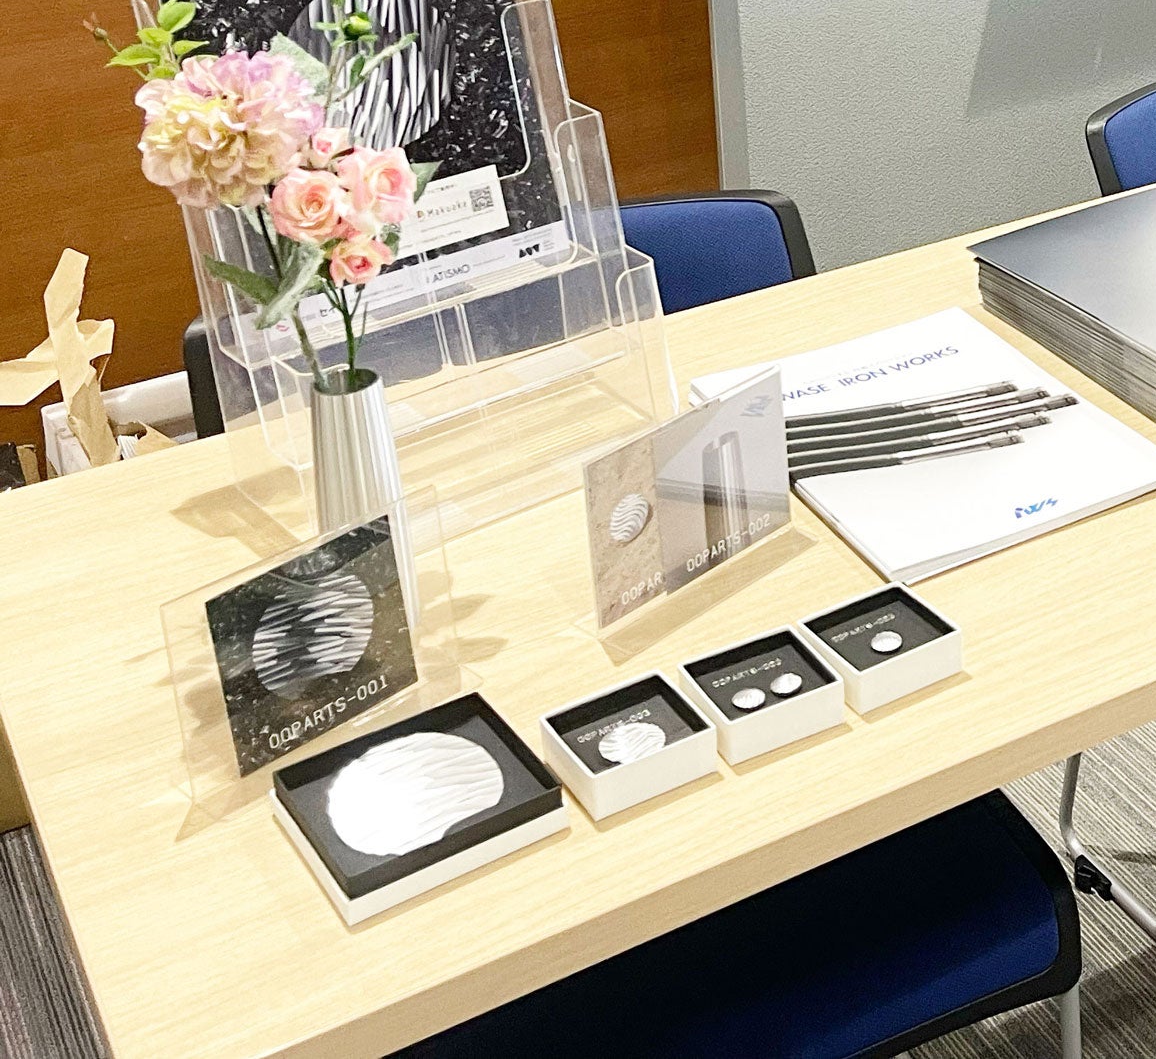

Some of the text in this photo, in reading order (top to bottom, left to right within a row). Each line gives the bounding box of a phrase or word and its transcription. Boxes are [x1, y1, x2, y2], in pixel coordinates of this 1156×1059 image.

[838, 367, 888, 388] IRON
[889, 345, 959, 372] WORKS
[686, 513, 771, 573] OOPARTS-002
[268, 675, 390, 751] OOPARTS-001
